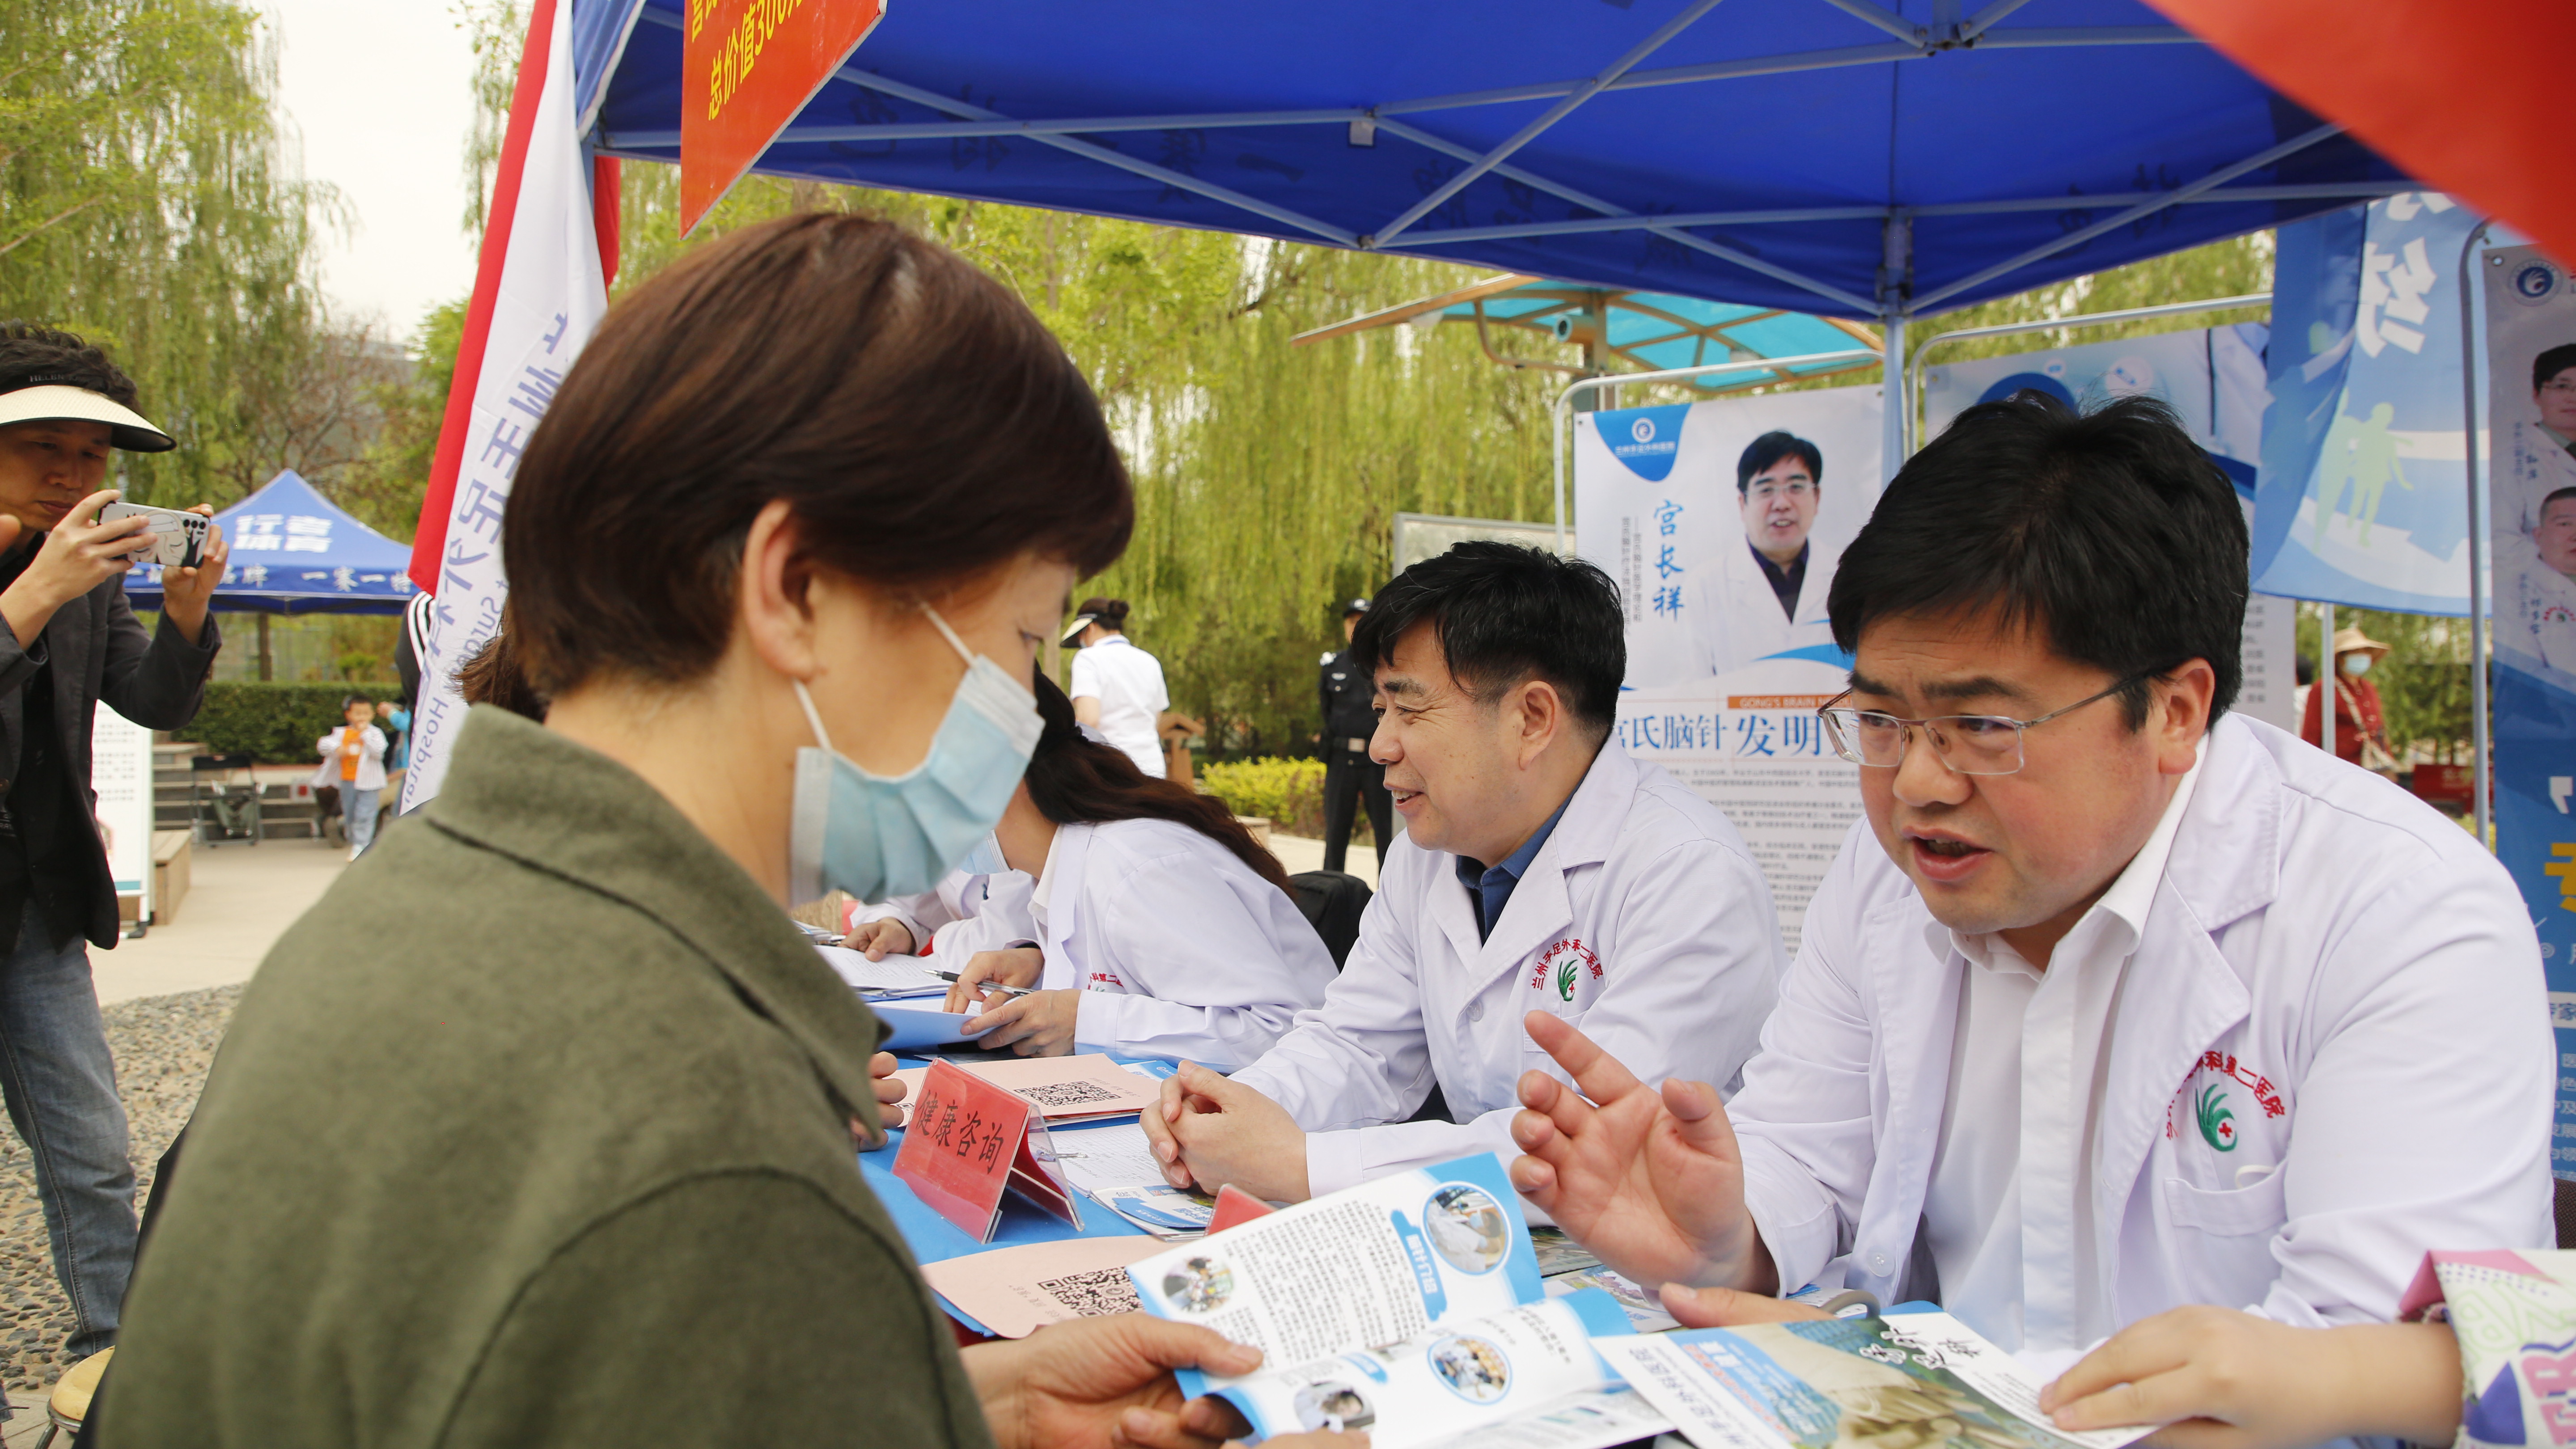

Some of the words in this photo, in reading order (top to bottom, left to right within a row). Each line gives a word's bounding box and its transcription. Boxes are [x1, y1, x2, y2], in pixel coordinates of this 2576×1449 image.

[1653, 500, 1684, 622] 宫长祥
[1783, 696, 1815, 708] BRAIN
[1616, 714, 1822, 757] 氏脑针发明
[916, 1089, 1004, 1174] 健康咨询
